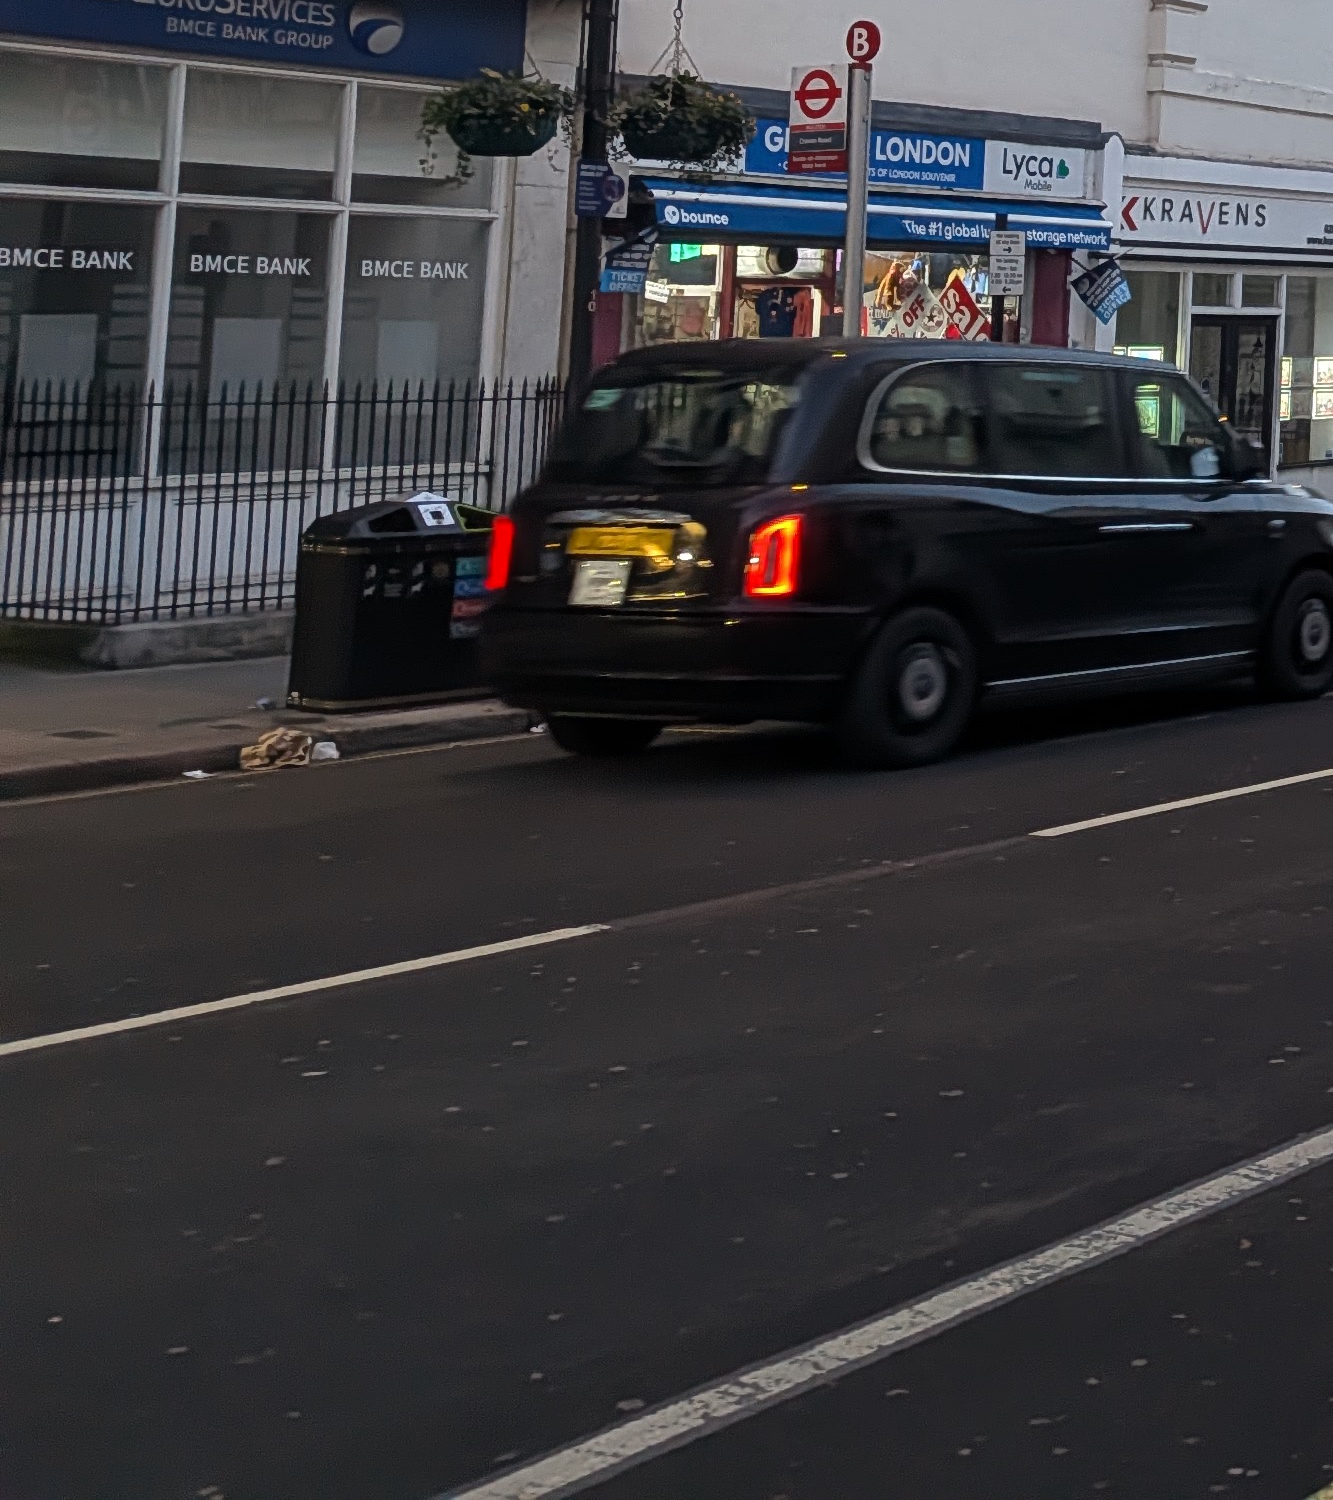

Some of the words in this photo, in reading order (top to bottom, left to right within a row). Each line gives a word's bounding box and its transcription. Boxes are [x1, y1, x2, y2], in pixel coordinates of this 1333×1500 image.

[166, 16, 217, 37] BMCE
[222, 23, 268, 43] BANK
[273, 29, 334, 49] GROUP
[853, 28, 870, 57] B
[875, 135, 971, 168] LONDON
[1002, 147, 1054, 181] Lyca
[877, 168, 888, 177] OF
[889, 169, 921, 180] LONDON
[1024, 178, 1052, 192] Mobile
[680, 209, 729, 226] bounce
[1142, 196, 1267, 235] KRAVENS
[902, 219, 927, 236] The
[928, 221, 943, 237] #1
[944, 222, 980, 240] global
[1026, 229, 1066, 246] storage
[1067, 230, 1108, 246] network
[0, 247, 63, 269] BMCE
[71, 249, 134, 270] BANK
[190, 254, 250, 274] BMCE
[255, 257, 312, 277] BANK
[360, 260, 414, 279] BMCE
[419, 261, 469, 280] BANK
[902, 294, 925, 327] OFF
